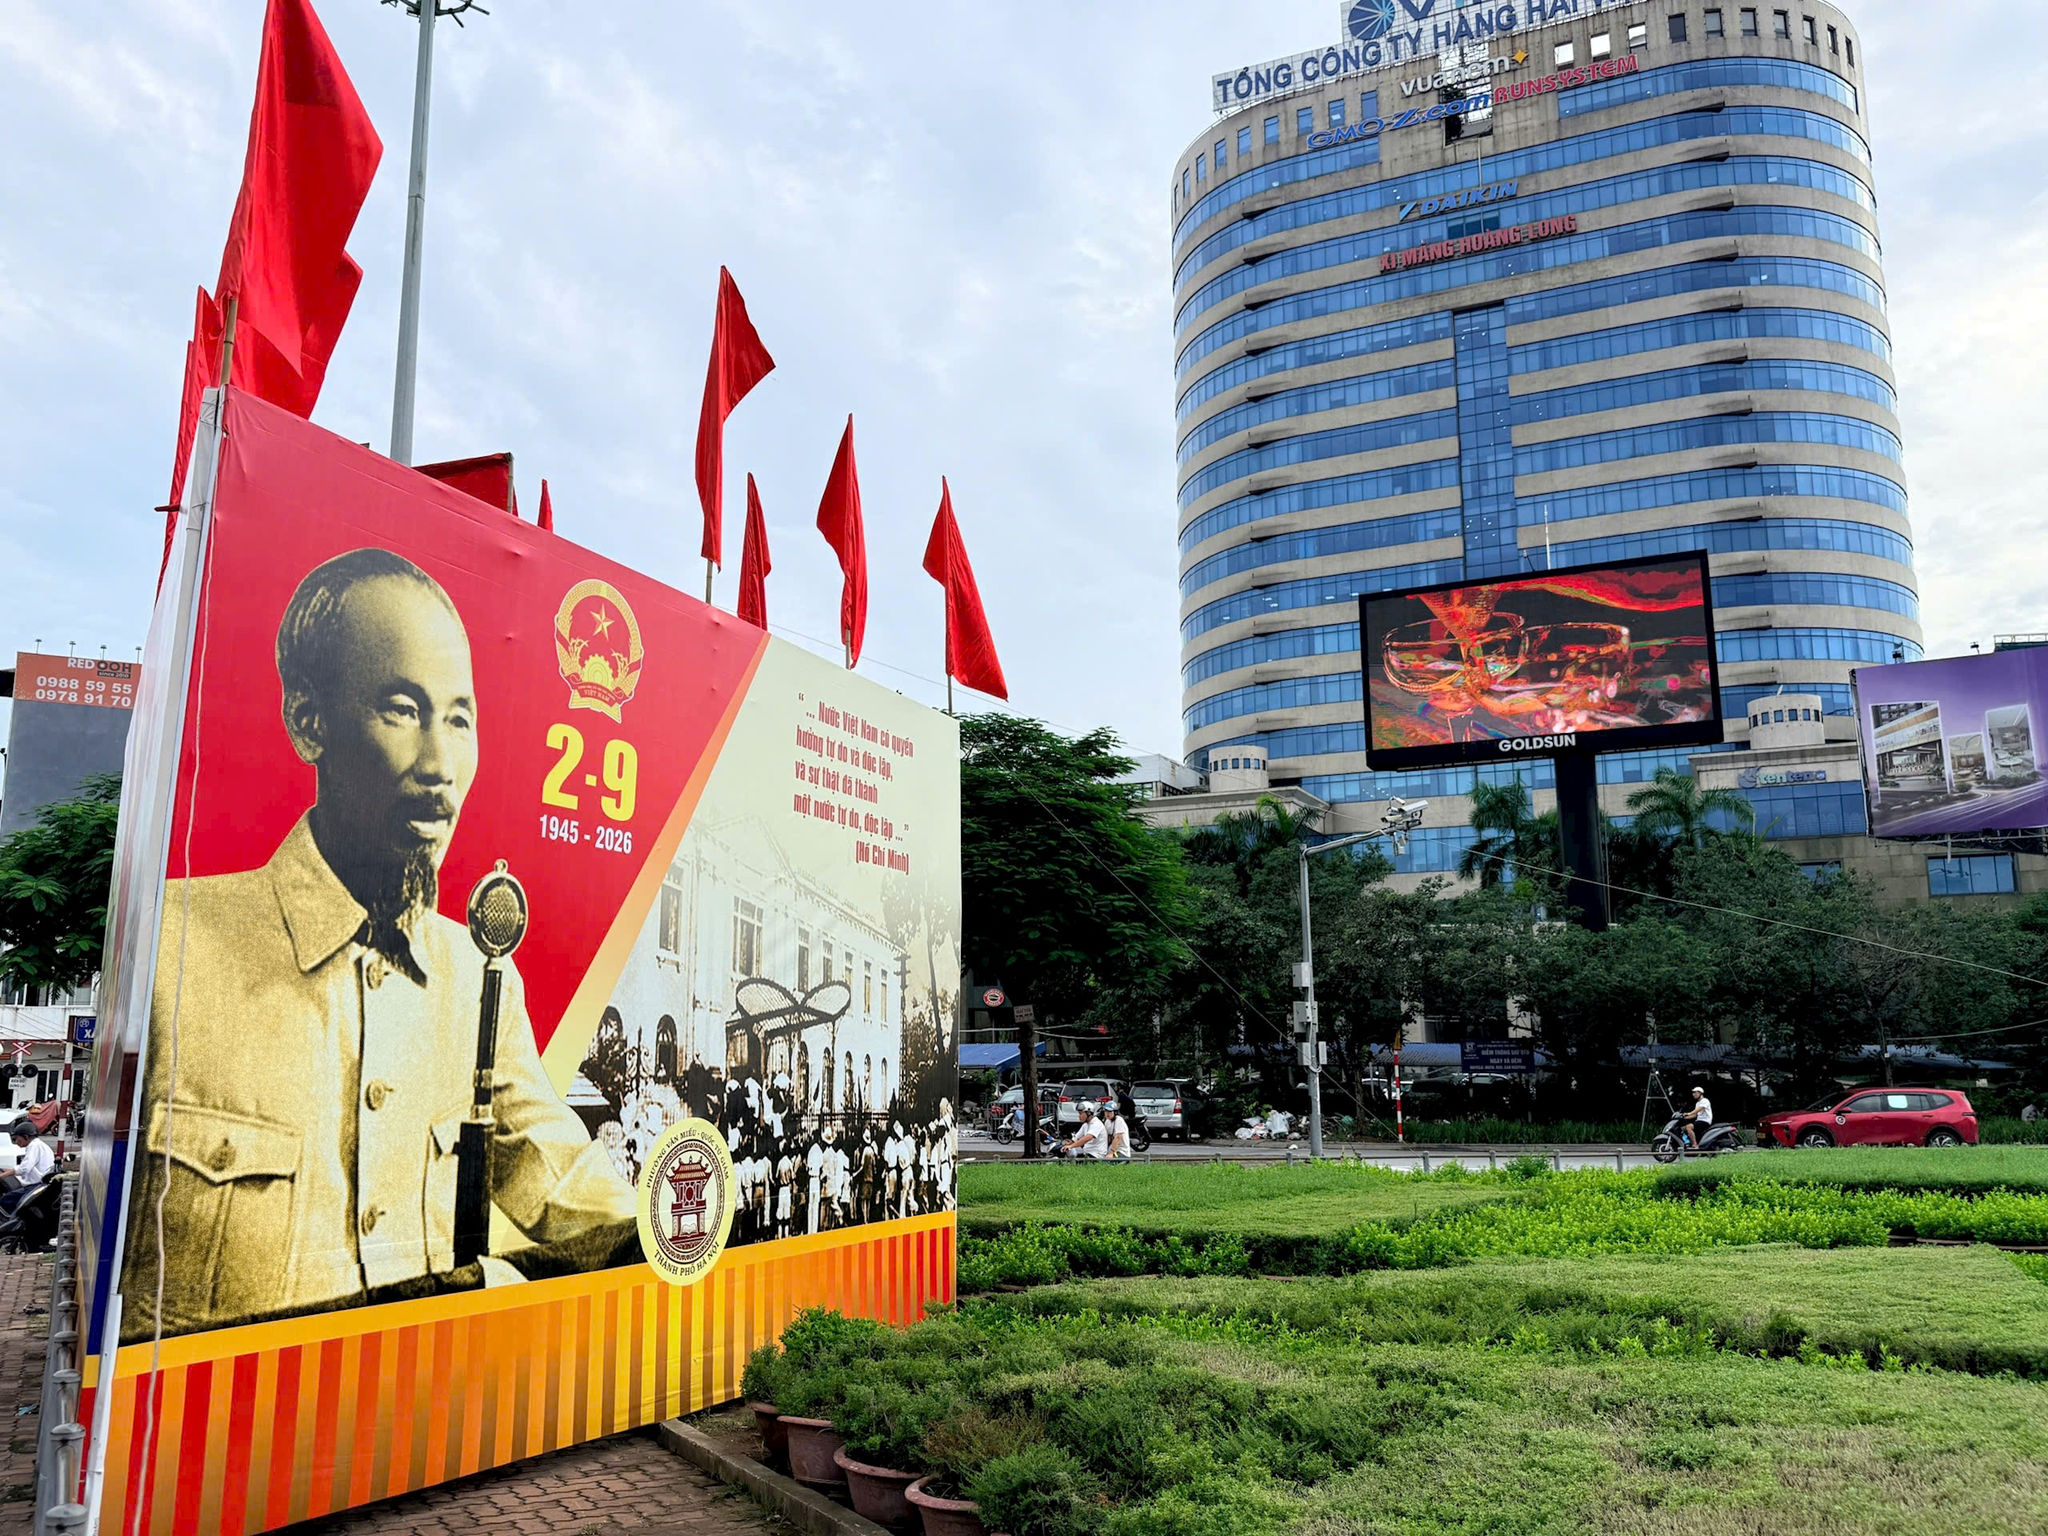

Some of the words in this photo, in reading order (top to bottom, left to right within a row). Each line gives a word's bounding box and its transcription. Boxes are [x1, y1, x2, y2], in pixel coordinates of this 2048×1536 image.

[1217, 64, 1292, 103] TỔNG
[1301, 41, 1382, 82] CÔNG
[1387, 27, 1423, 60] TY
[1433, 4, 1517, 49] HÀNG
[1400, 54, 1510, 97] vuanem
[1493, 54, 1639, 104] RUNSYSTEM
[1420, 181, 1519, 216] DAIKIN
[1379, 254, 1397, 271] XI
[1459, 228, 1522, 254] HOÀNG
[1528, 215, 1577, 240] LONG
[67, 657, 95, 670] RED
[97, 660, 132, 673] OOH
[35, 689, 78, 703] 0978
[84, 693, 103, 705] 91
[111, 696, 131, 707] 70
[36, 676, 79, 689] 0988
[85, 679, 106, 692] 59
[111, 683, 132, 694] 55
[818, 701, 840, 729] Nước
[843, 711, 858, 739] Việt
[861, 719, 878, 744] Nam
[838, 741, 848, 763] do
[1498, 733, 1576, 752] GOLDSUN
[541, 723, 638, 822] 2-9
[795, 759, 806, 781] và
[793, 794, 811, 818] một
[814, 800, 835, 822] nước
[849, 808, 862, 833] do,
[539, 814, 579, 845] 1945
[584, 833, 591, 841] -
[595, 825, 632, 854] 2026
[654, 1249, 678, 1275] THÀNH
